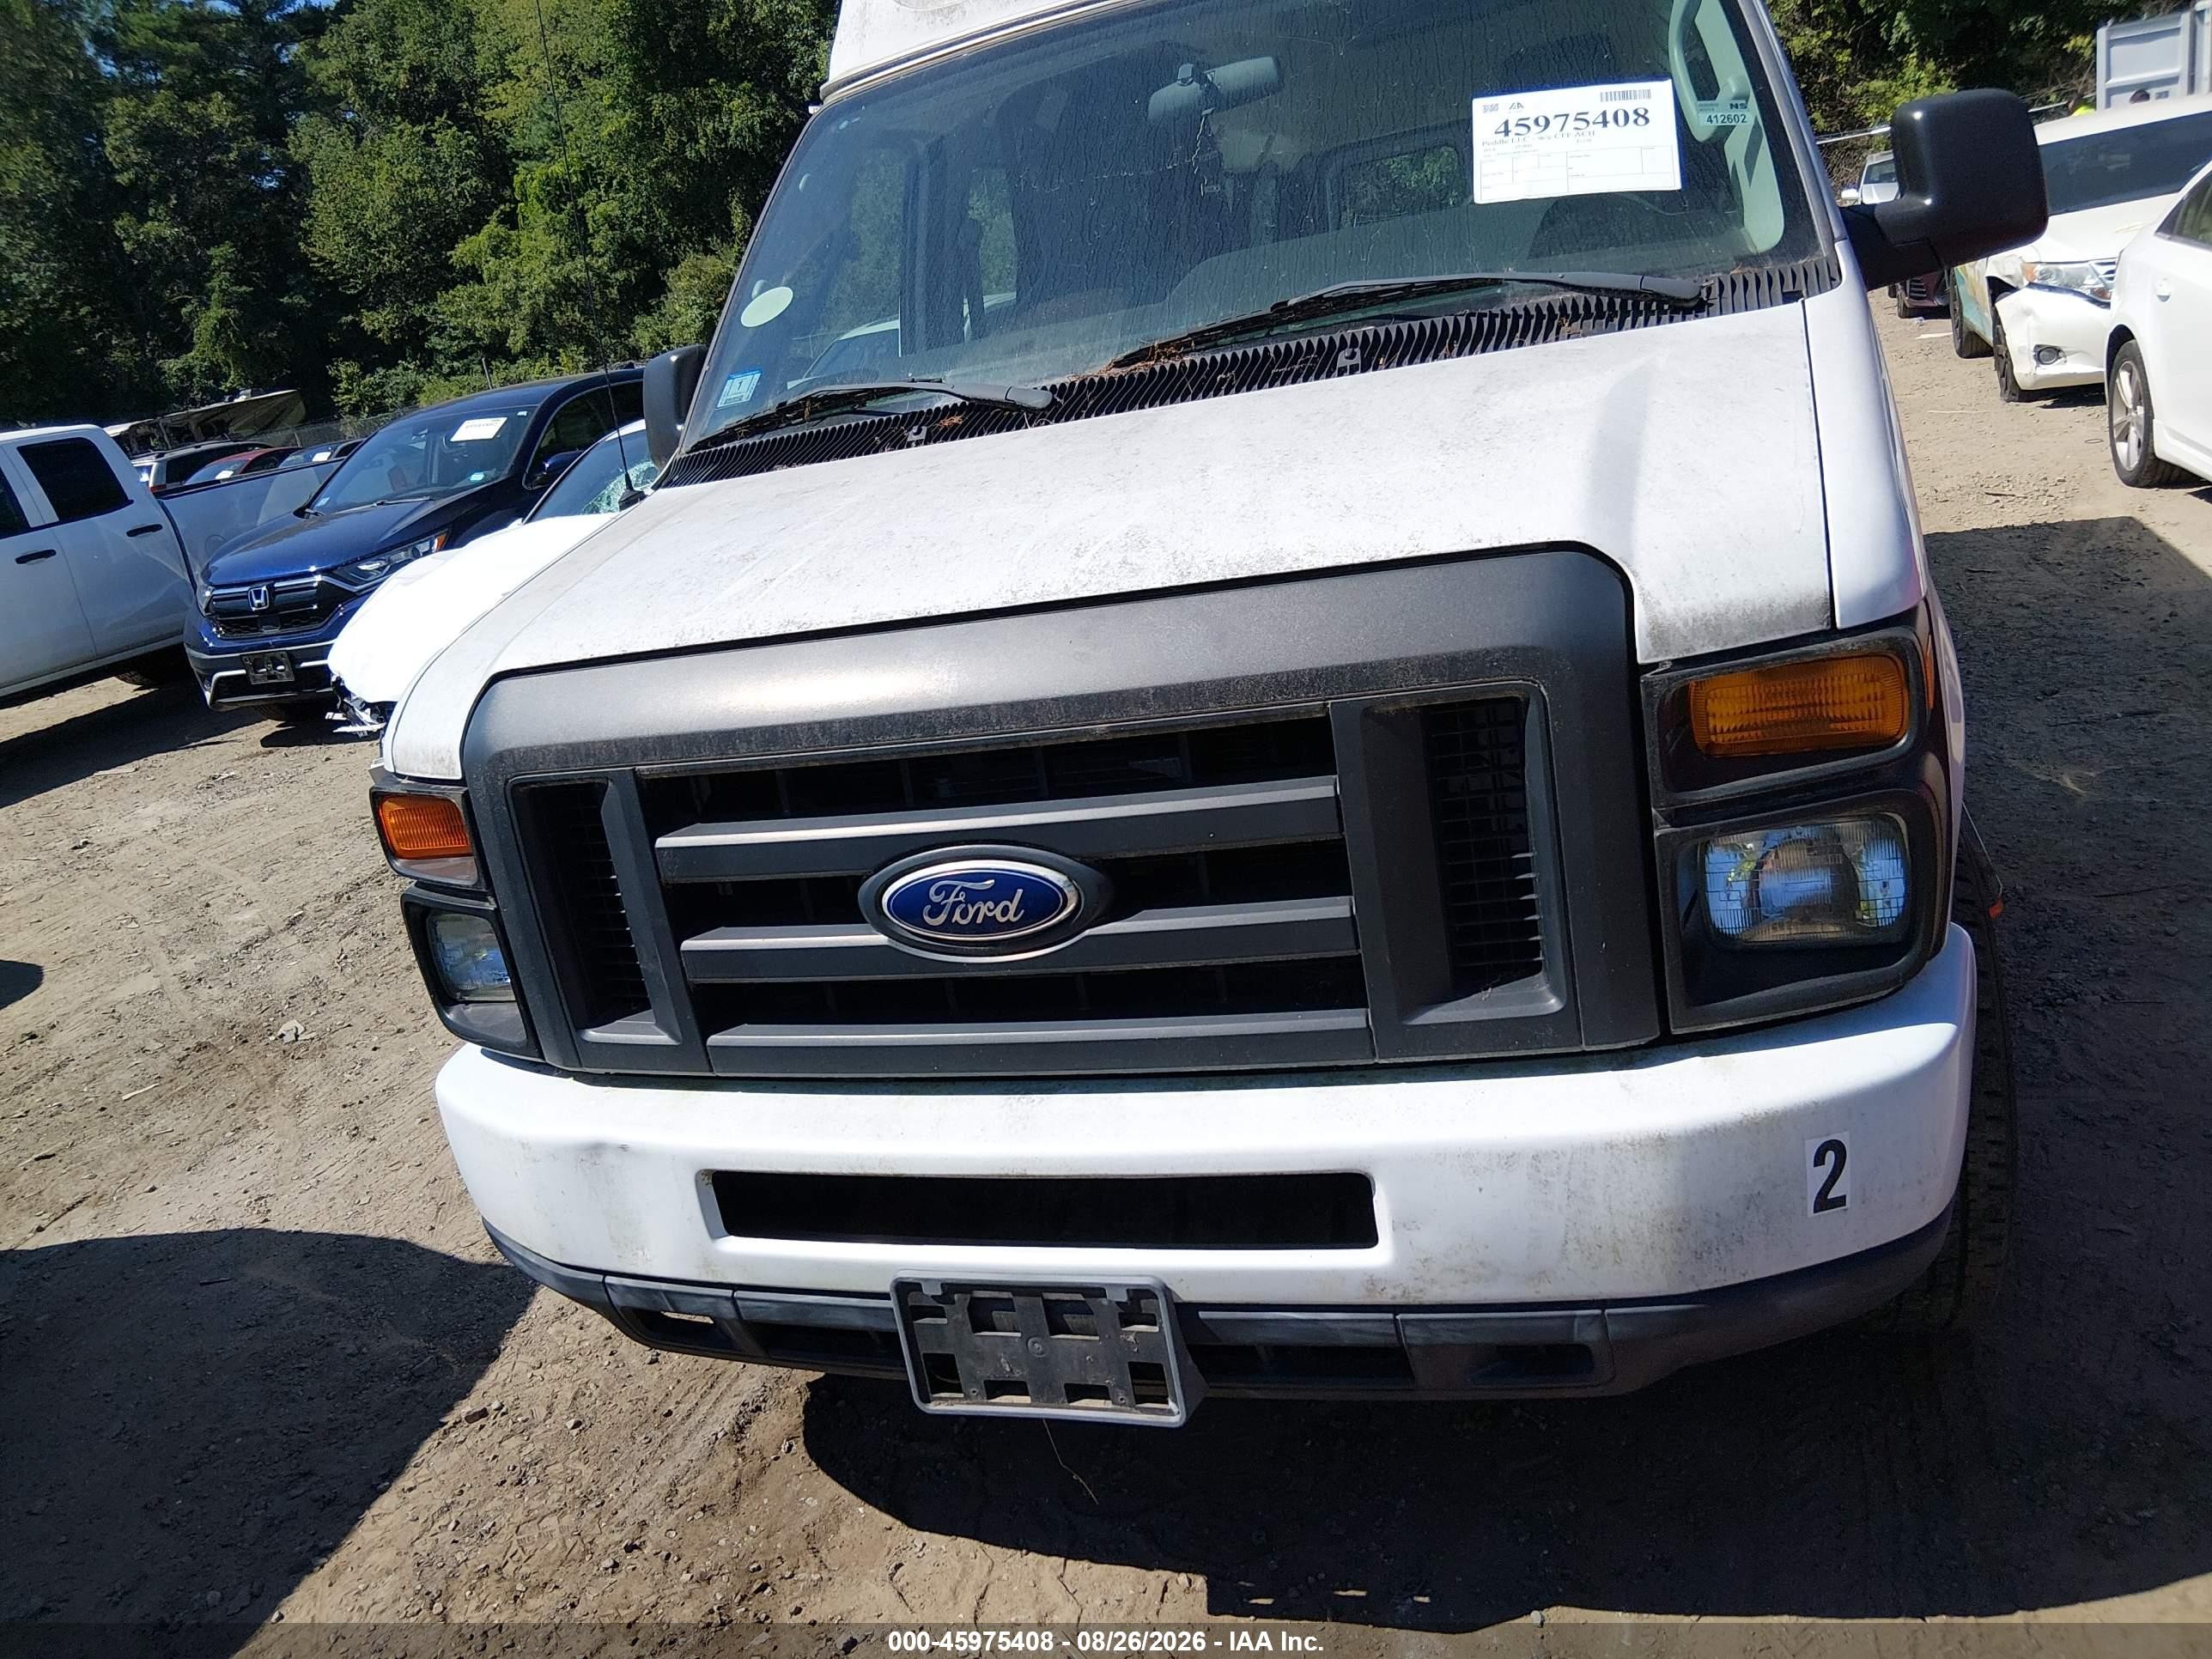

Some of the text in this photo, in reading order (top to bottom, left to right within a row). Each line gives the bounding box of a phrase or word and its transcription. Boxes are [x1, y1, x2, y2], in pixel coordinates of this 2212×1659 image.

[1493, 107, 1650, 137] 45975408
[1706, 113, 1747, 124] 412602
[922, 879, 1024, 927] Ford
[1813, 1139, 1847, 1213] 2
